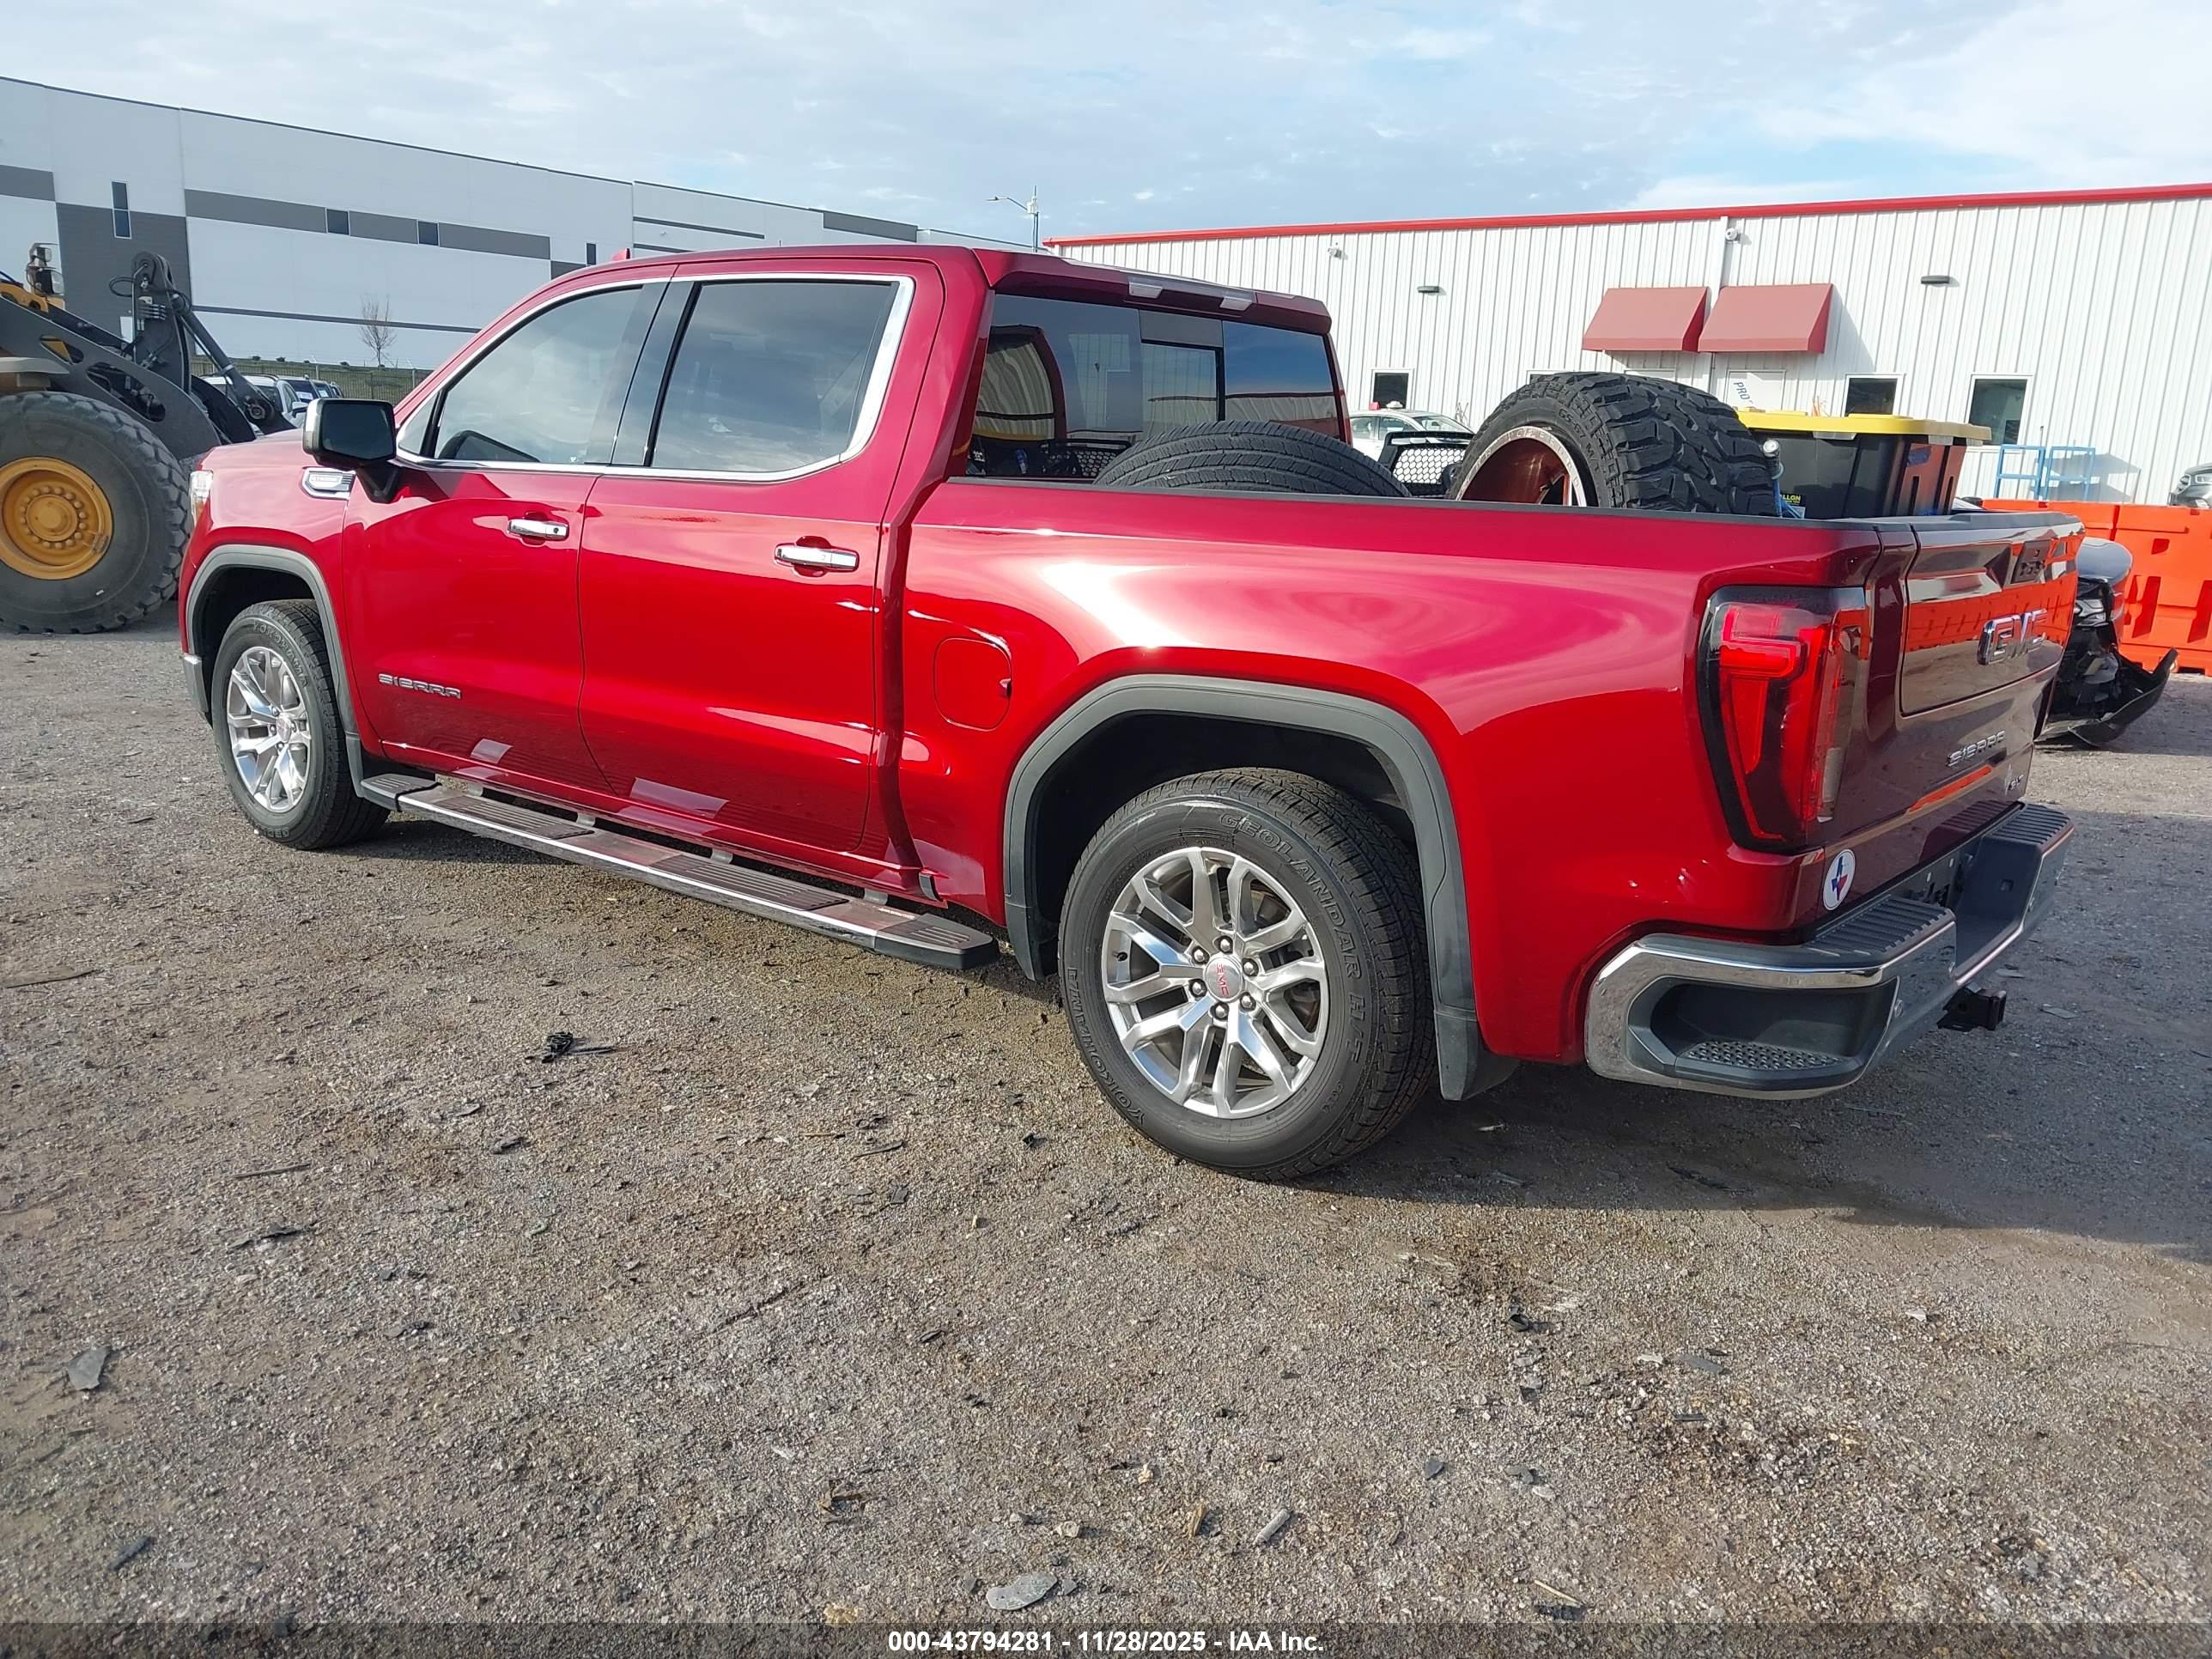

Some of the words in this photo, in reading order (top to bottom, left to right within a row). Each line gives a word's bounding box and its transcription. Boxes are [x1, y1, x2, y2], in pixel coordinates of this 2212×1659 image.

[1733, 381, 1753, 404] PRO
[1977, 607, 2048, 666] GMC
[378, 673, 461, 700] SIERRA
[1945, 729, 2006, 767] SIERRA
[1219, 812, 1363, 981] GEOLANDAR
[1344, 991, 1366, 1065] H/T
[1215, 963, 1231, 998] GMC
[1066, 967, 1147, 1127] YOKOHAMA
